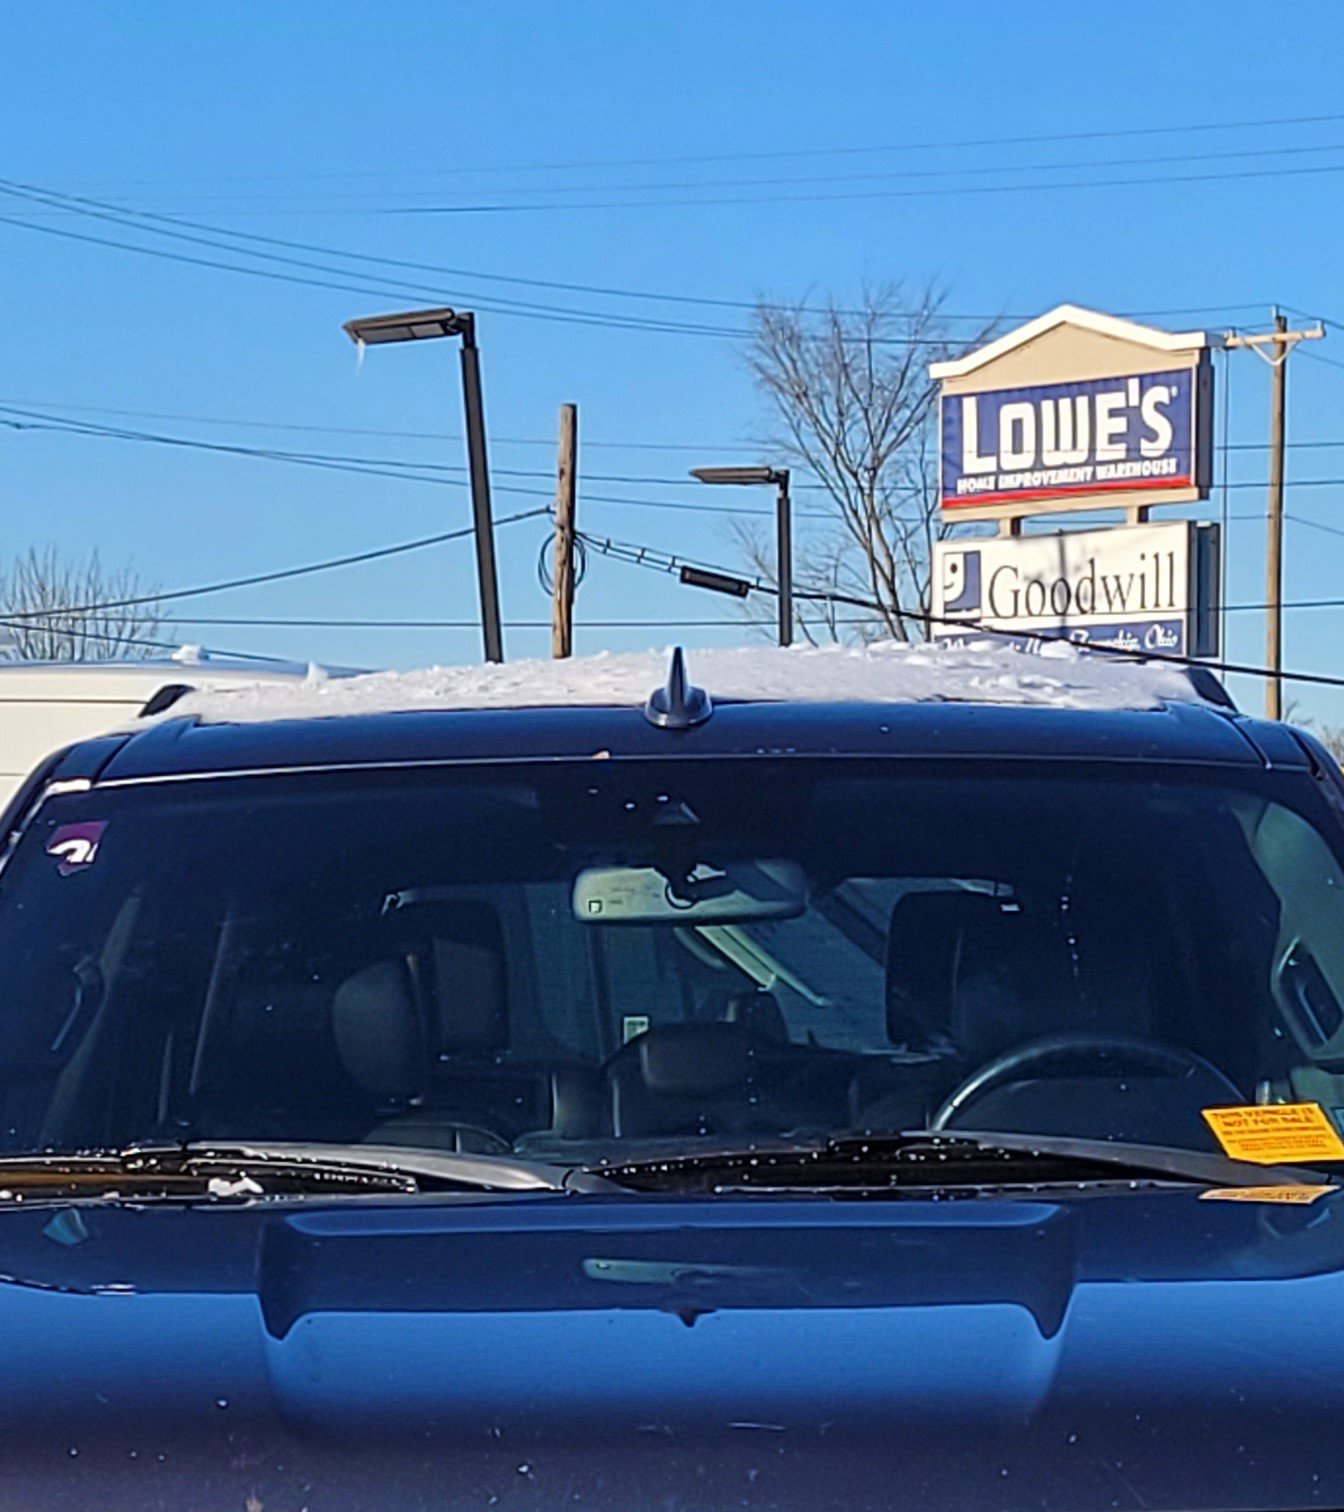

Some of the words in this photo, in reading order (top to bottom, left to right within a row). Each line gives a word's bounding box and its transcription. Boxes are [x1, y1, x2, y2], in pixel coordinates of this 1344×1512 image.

[962, 377, 1173, 475] LOWE'S
[956, 476, 996, 495] HOME
[997, 466, 1094, 491] IMPROVEMENT
[1095, 457, 1178, 483] WAREHOUSE
[988, 552, 1176, 620] Goodwill
